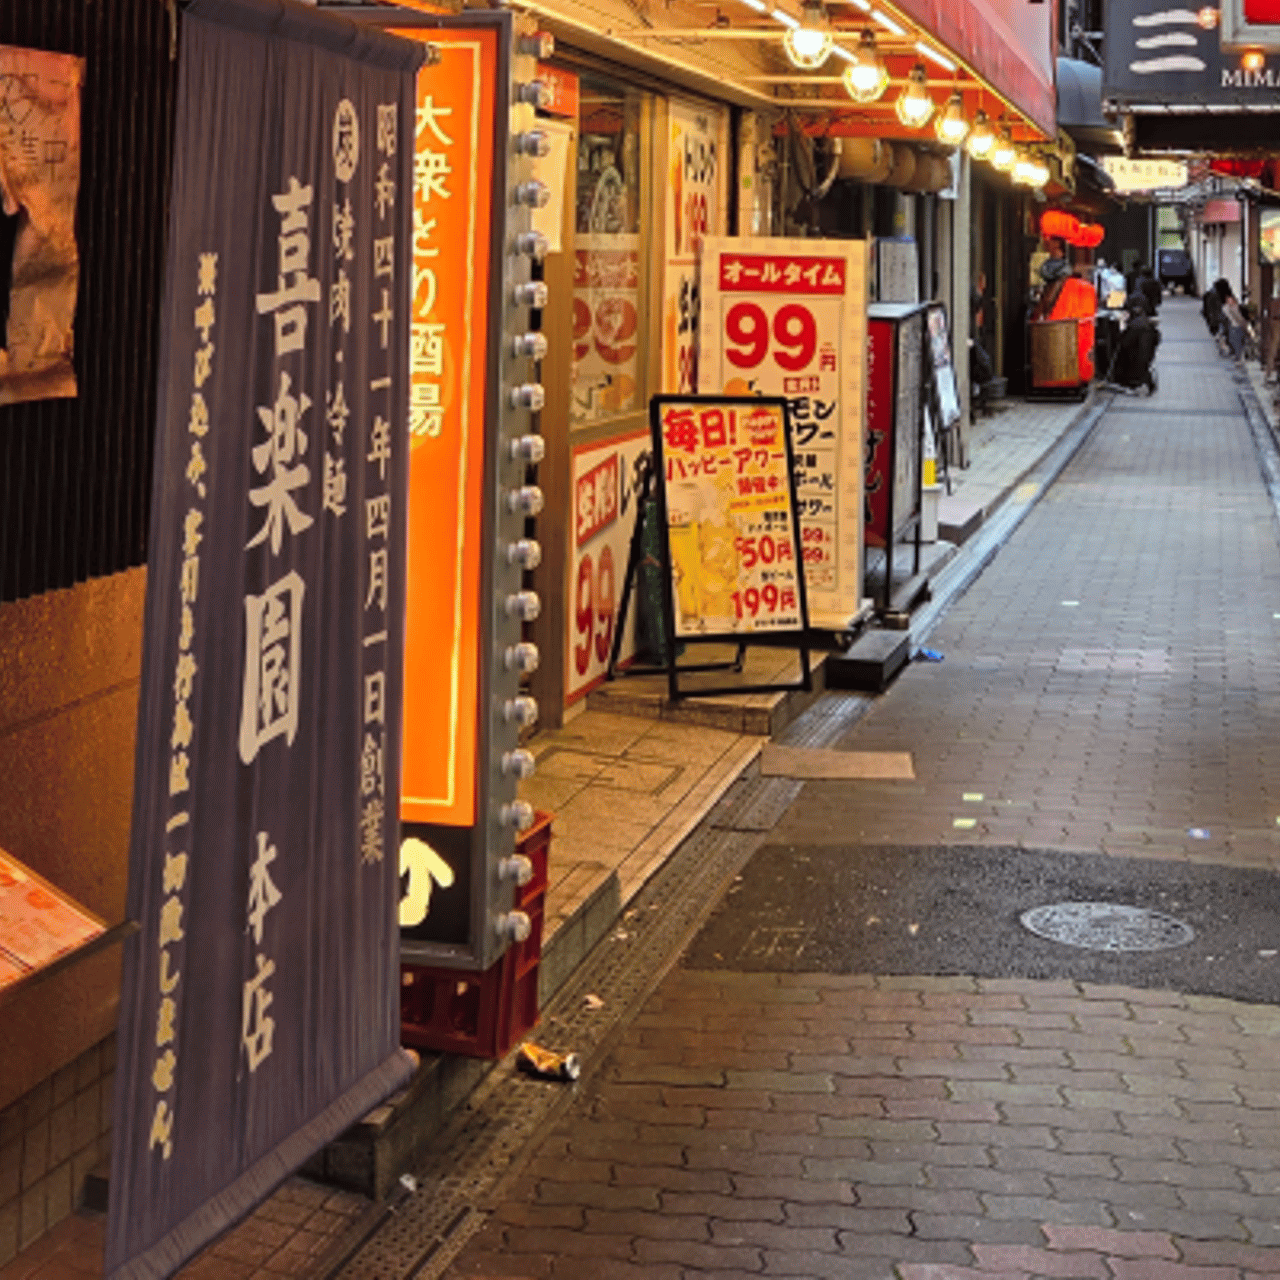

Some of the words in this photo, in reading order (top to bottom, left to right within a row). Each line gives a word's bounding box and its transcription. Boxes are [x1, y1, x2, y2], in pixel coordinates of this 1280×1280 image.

[723, 261, 841, 286] オールタイム
[725, 301, 817, 372] 99
[665, 407, 738, 454] 毎日!
[240, 176, 320, 764] 喜楽園
[361, 102, 399, 865] 昭和四十一年四月一日創業
[666, 447, 785, 482] ハッピーアワー
[730, 583, 797, 621] 199円
[240, 831, 283, 1074] 本店
